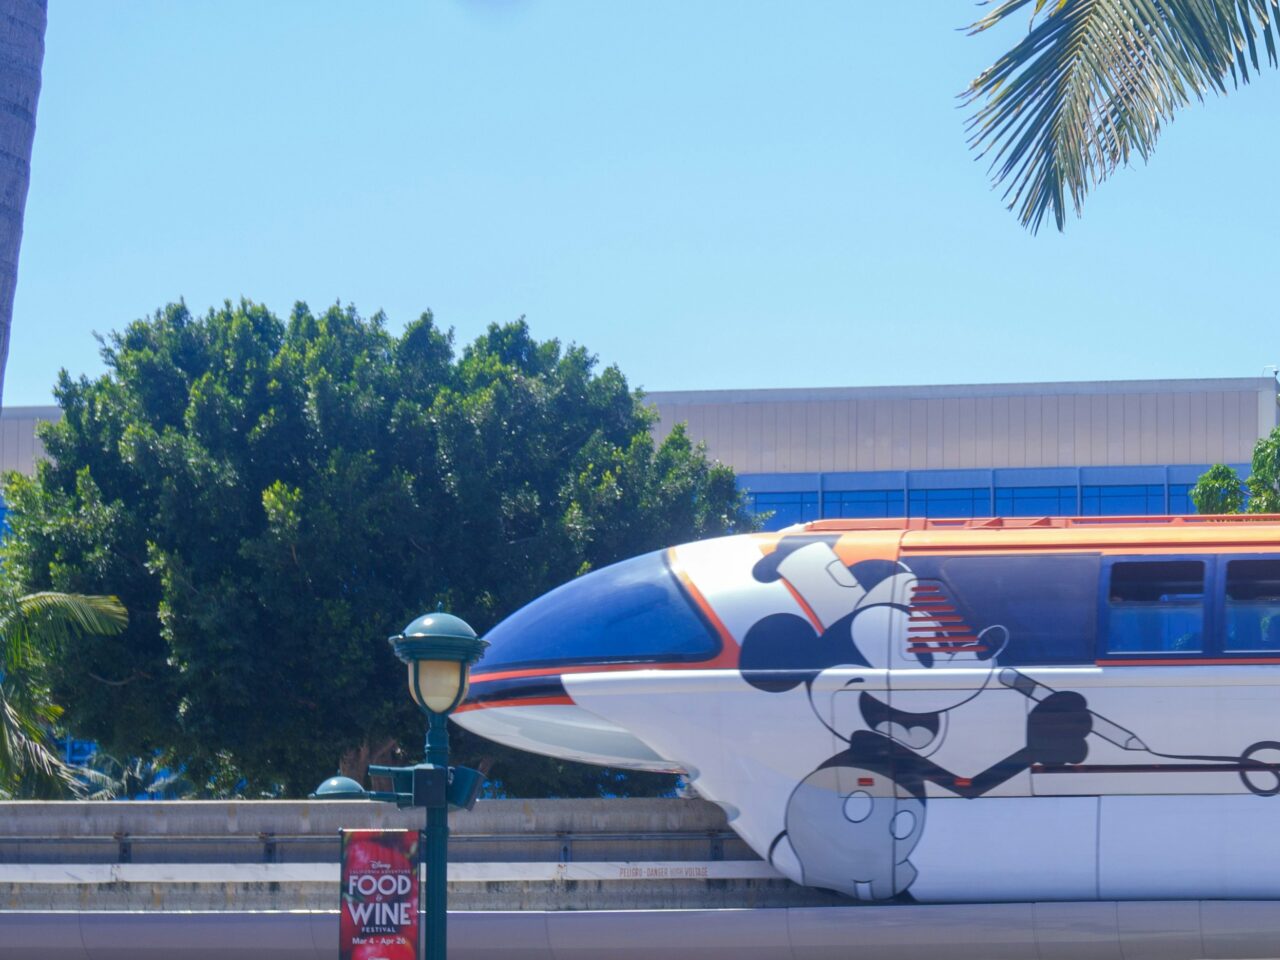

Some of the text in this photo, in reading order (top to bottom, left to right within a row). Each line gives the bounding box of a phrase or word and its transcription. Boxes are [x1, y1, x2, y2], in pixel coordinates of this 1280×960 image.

[349, 875, 411, 895] FOOD
[348, 902, 411, 926] WINE
[352, 937, 367, 945] Mar
[380, 937, 394, 946] Apr
[396, 937, 406, 945] 26
